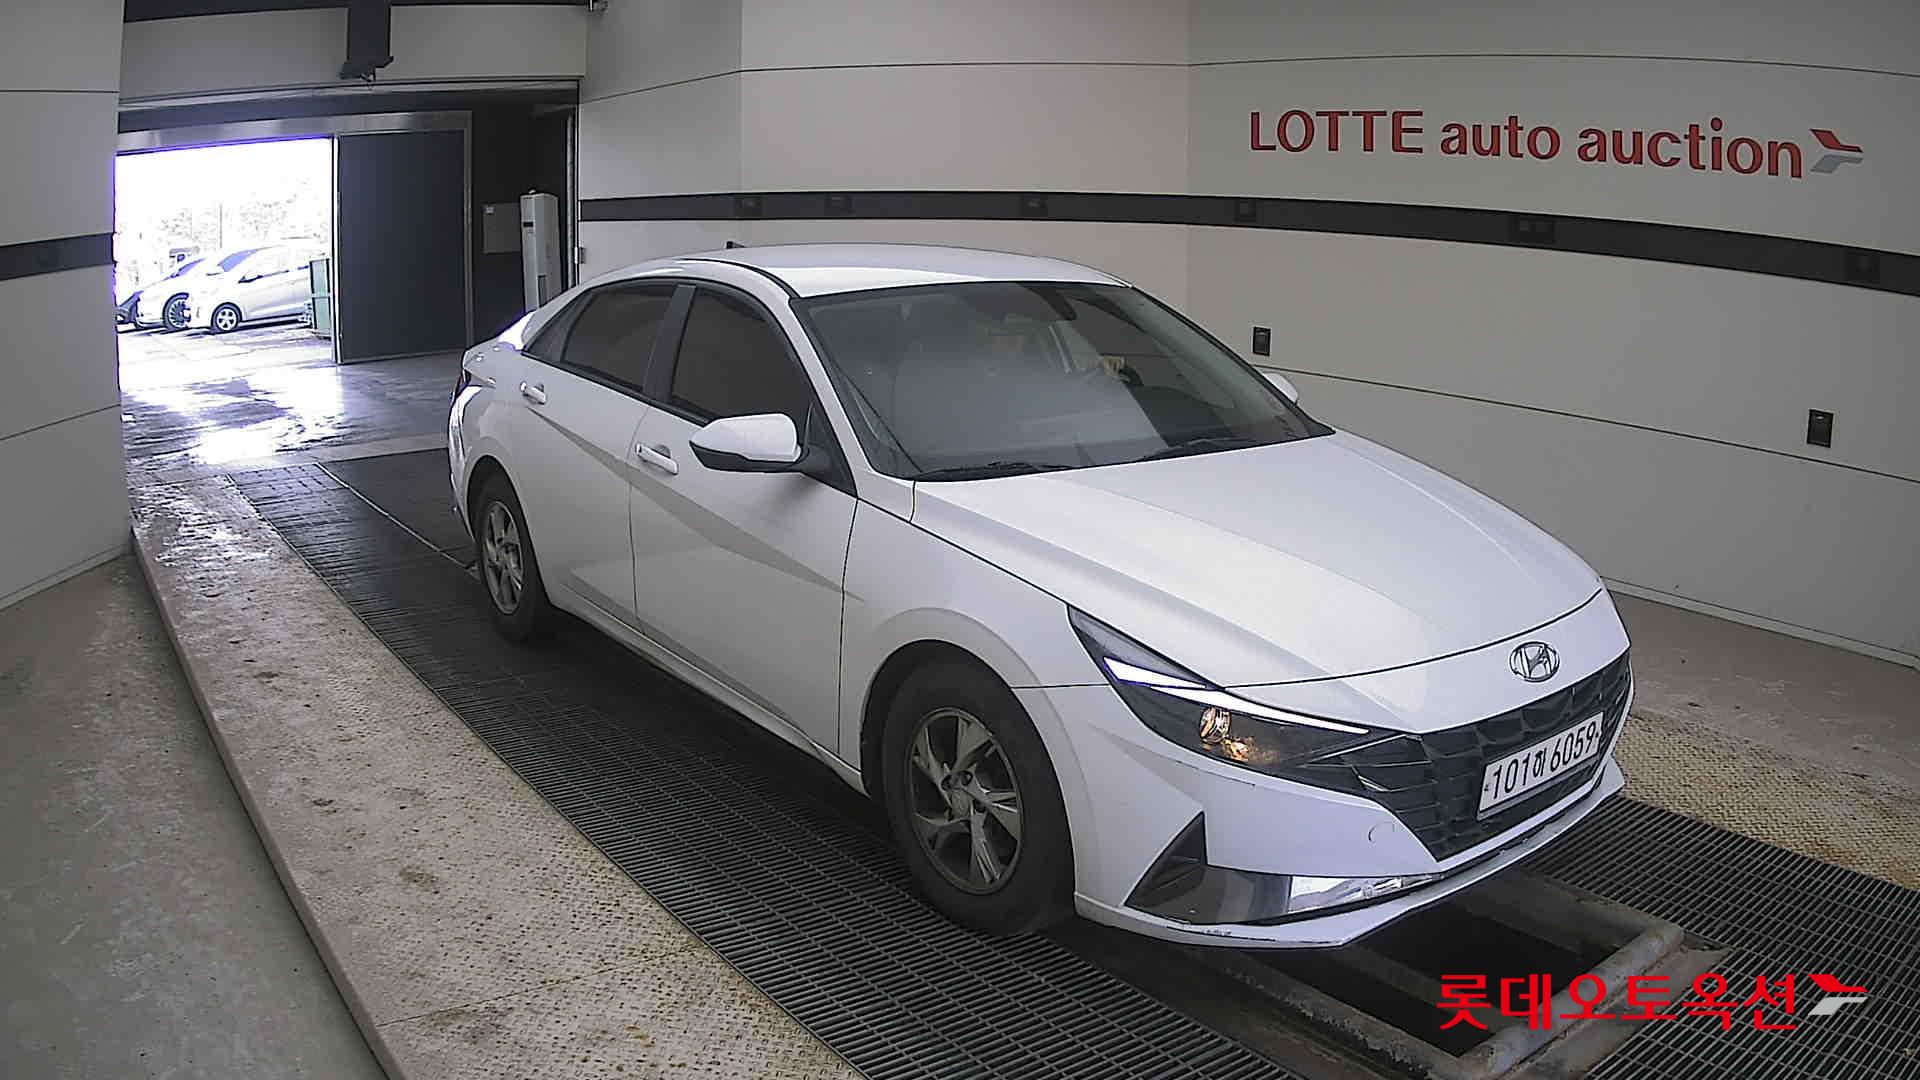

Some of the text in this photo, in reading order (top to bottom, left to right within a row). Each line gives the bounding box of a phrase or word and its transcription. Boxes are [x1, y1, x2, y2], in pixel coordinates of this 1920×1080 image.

[1250, 110, 1804, 179] LOTTE auto auction
